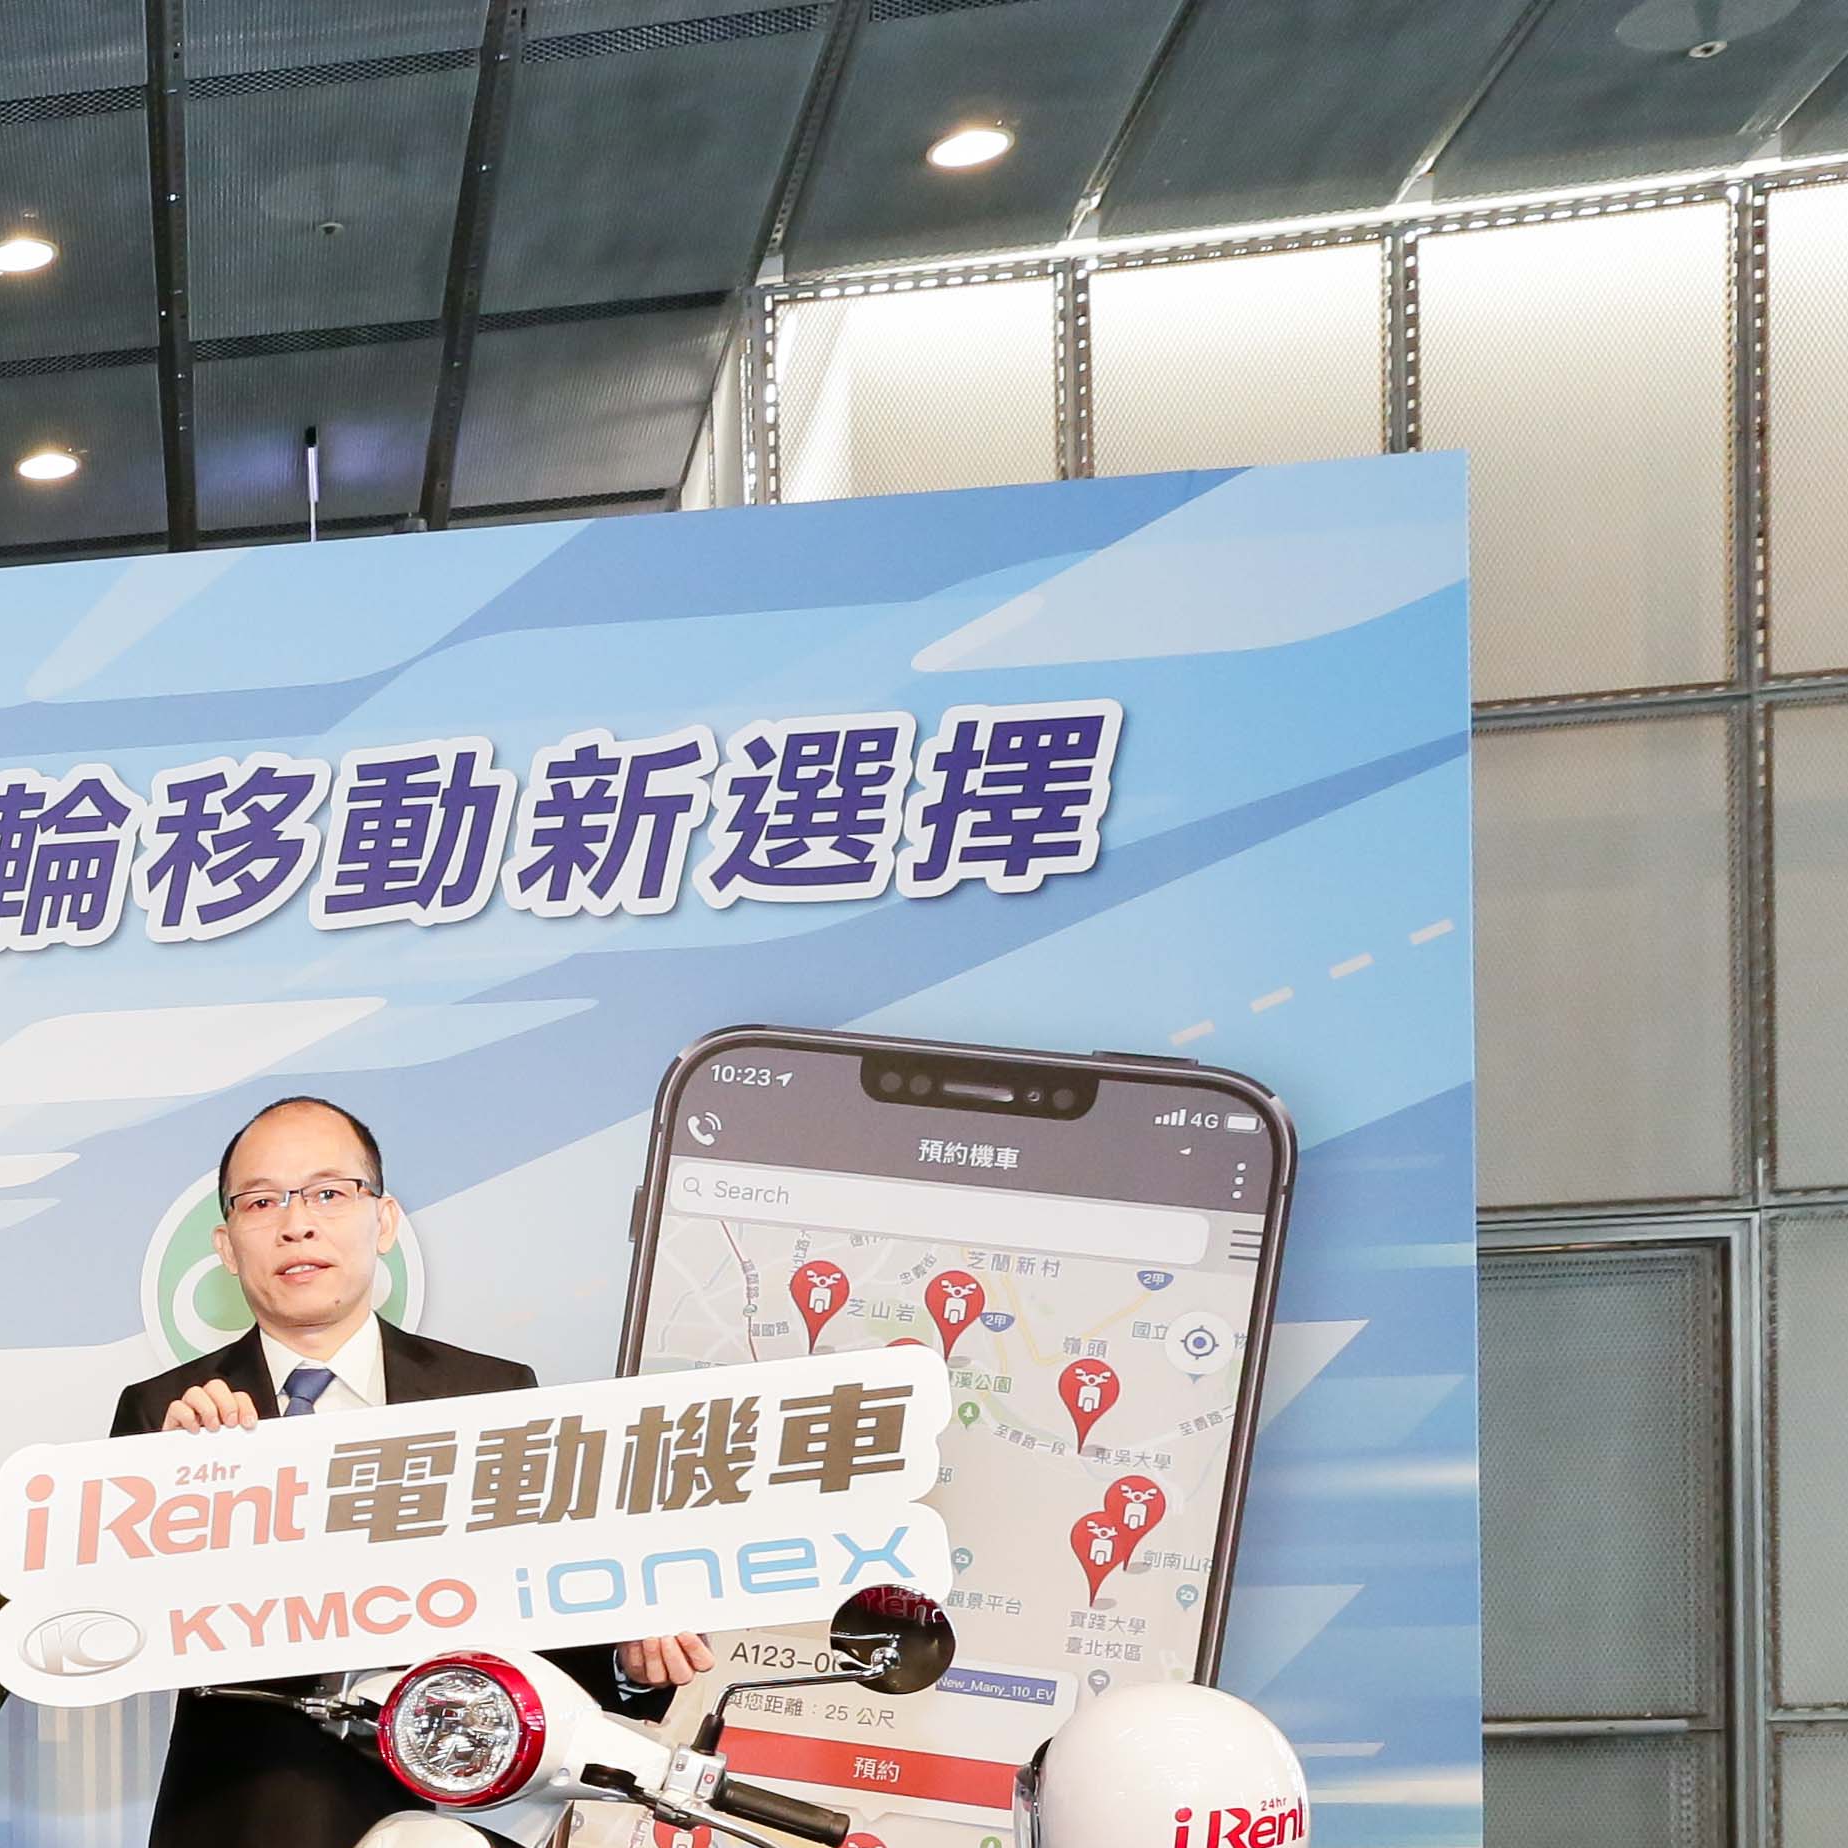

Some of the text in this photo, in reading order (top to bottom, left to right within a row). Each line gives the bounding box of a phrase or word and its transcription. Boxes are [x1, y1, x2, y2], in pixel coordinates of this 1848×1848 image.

[710, 1064, 772, 1087] 10:23
[1191, 1111, 1219, 1131] 4G
[918, 1139, 1019, 1170] 預約機車
[714, 1179, 790, 1206] Search
[949, 1370, 1012, 1394] 溪公園
[23, 1383, 914, 1571] iRent 電動機車
[176, 1461, 242, 1487] 24hr
[168, 1578, 478, 1656] KYMCO
[514, 1525, 917, 1620] ionex
[730, 1642, 839, 1674] A123-0
[825, 1704, 849, 1721] 25
[856, 1708, 895, 1729] 公尺
[853, 1756, 901, 1784] 預約
[1260, 1797, 1287, 1812] 24hr
